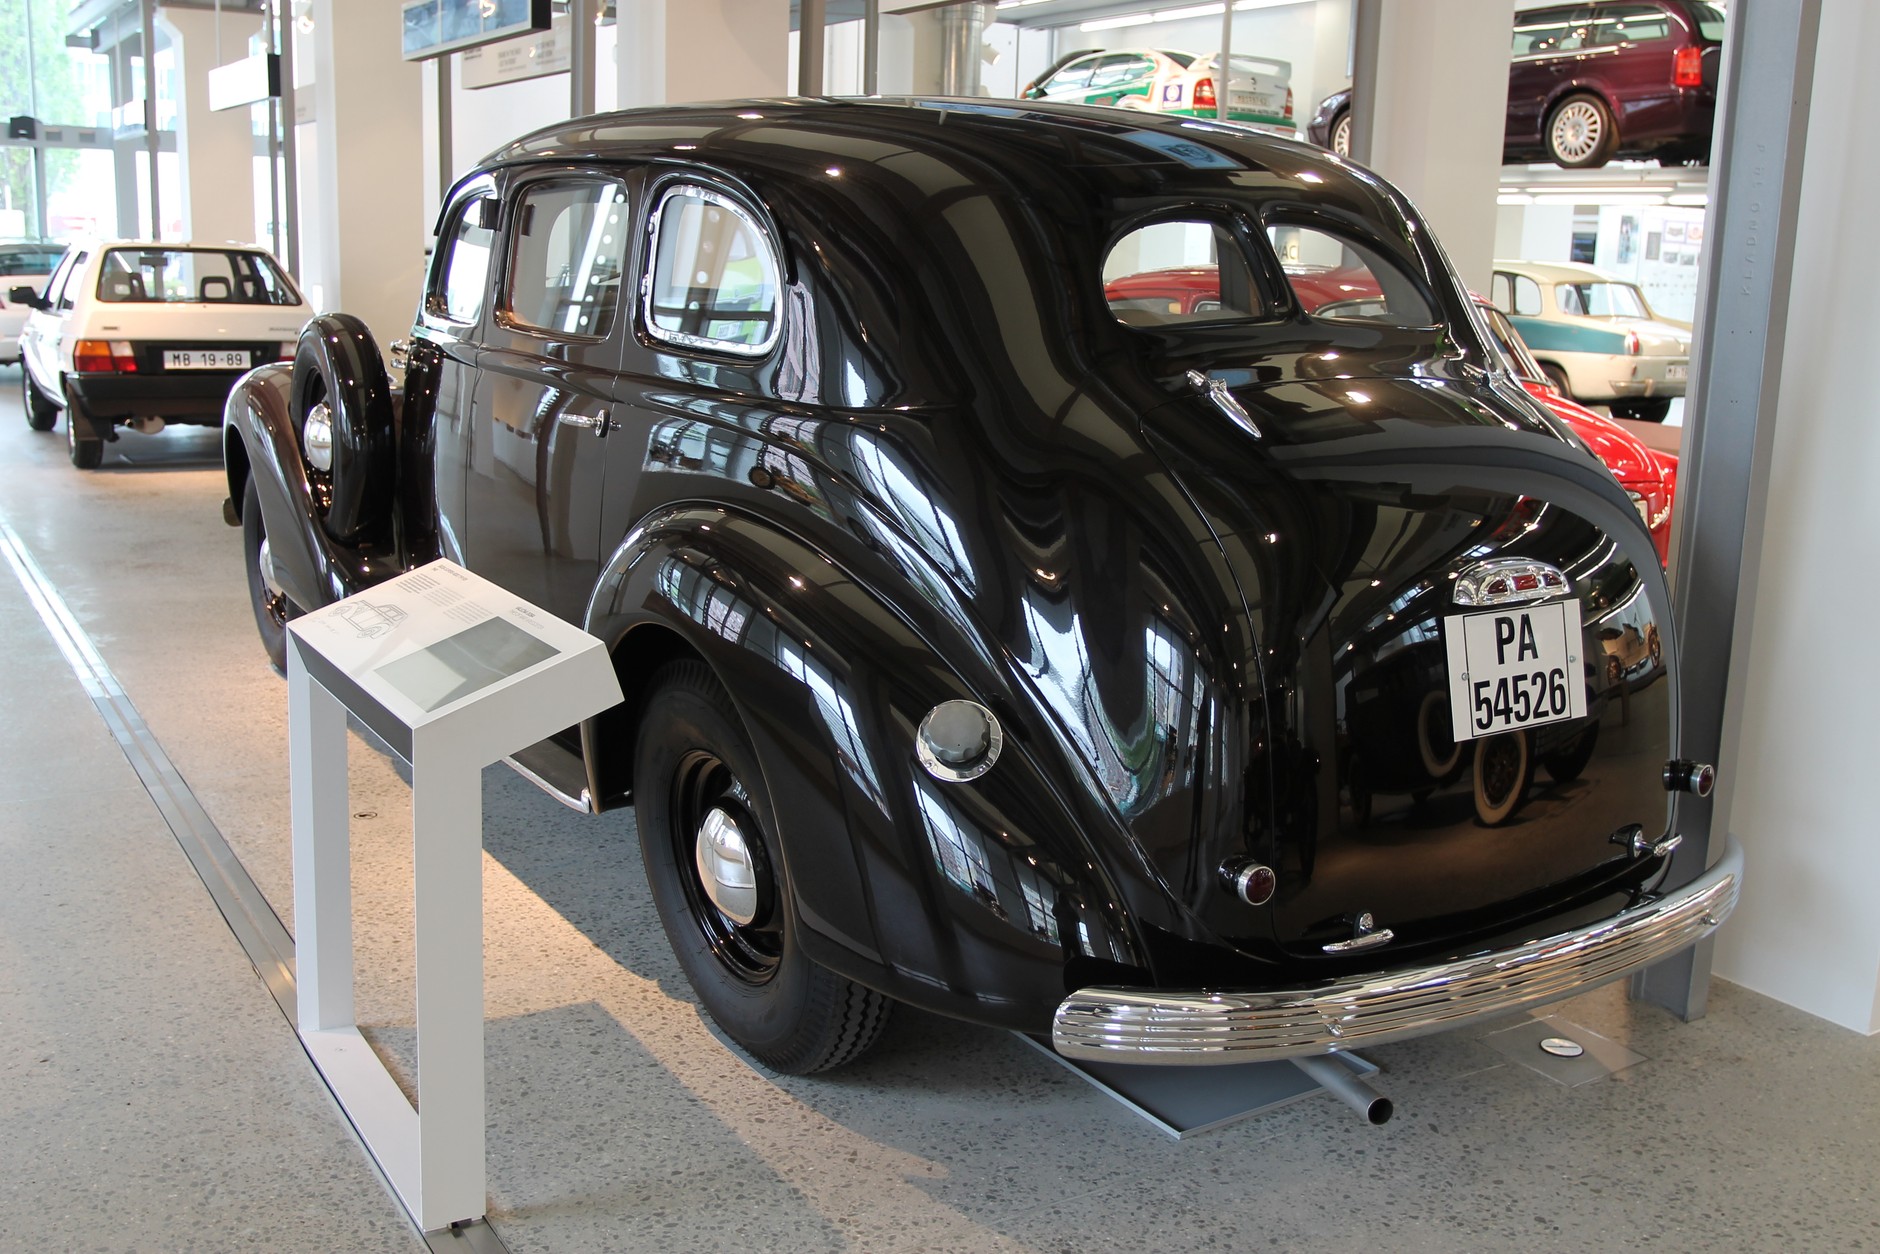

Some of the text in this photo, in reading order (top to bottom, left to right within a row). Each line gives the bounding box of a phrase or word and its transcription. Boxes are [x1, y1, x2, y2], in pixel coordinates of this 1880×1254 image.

[173, 353, 191, 367] MB
[1494, 613, 1538, 665] PA
[1473, 668, 1566, 730] 54526
